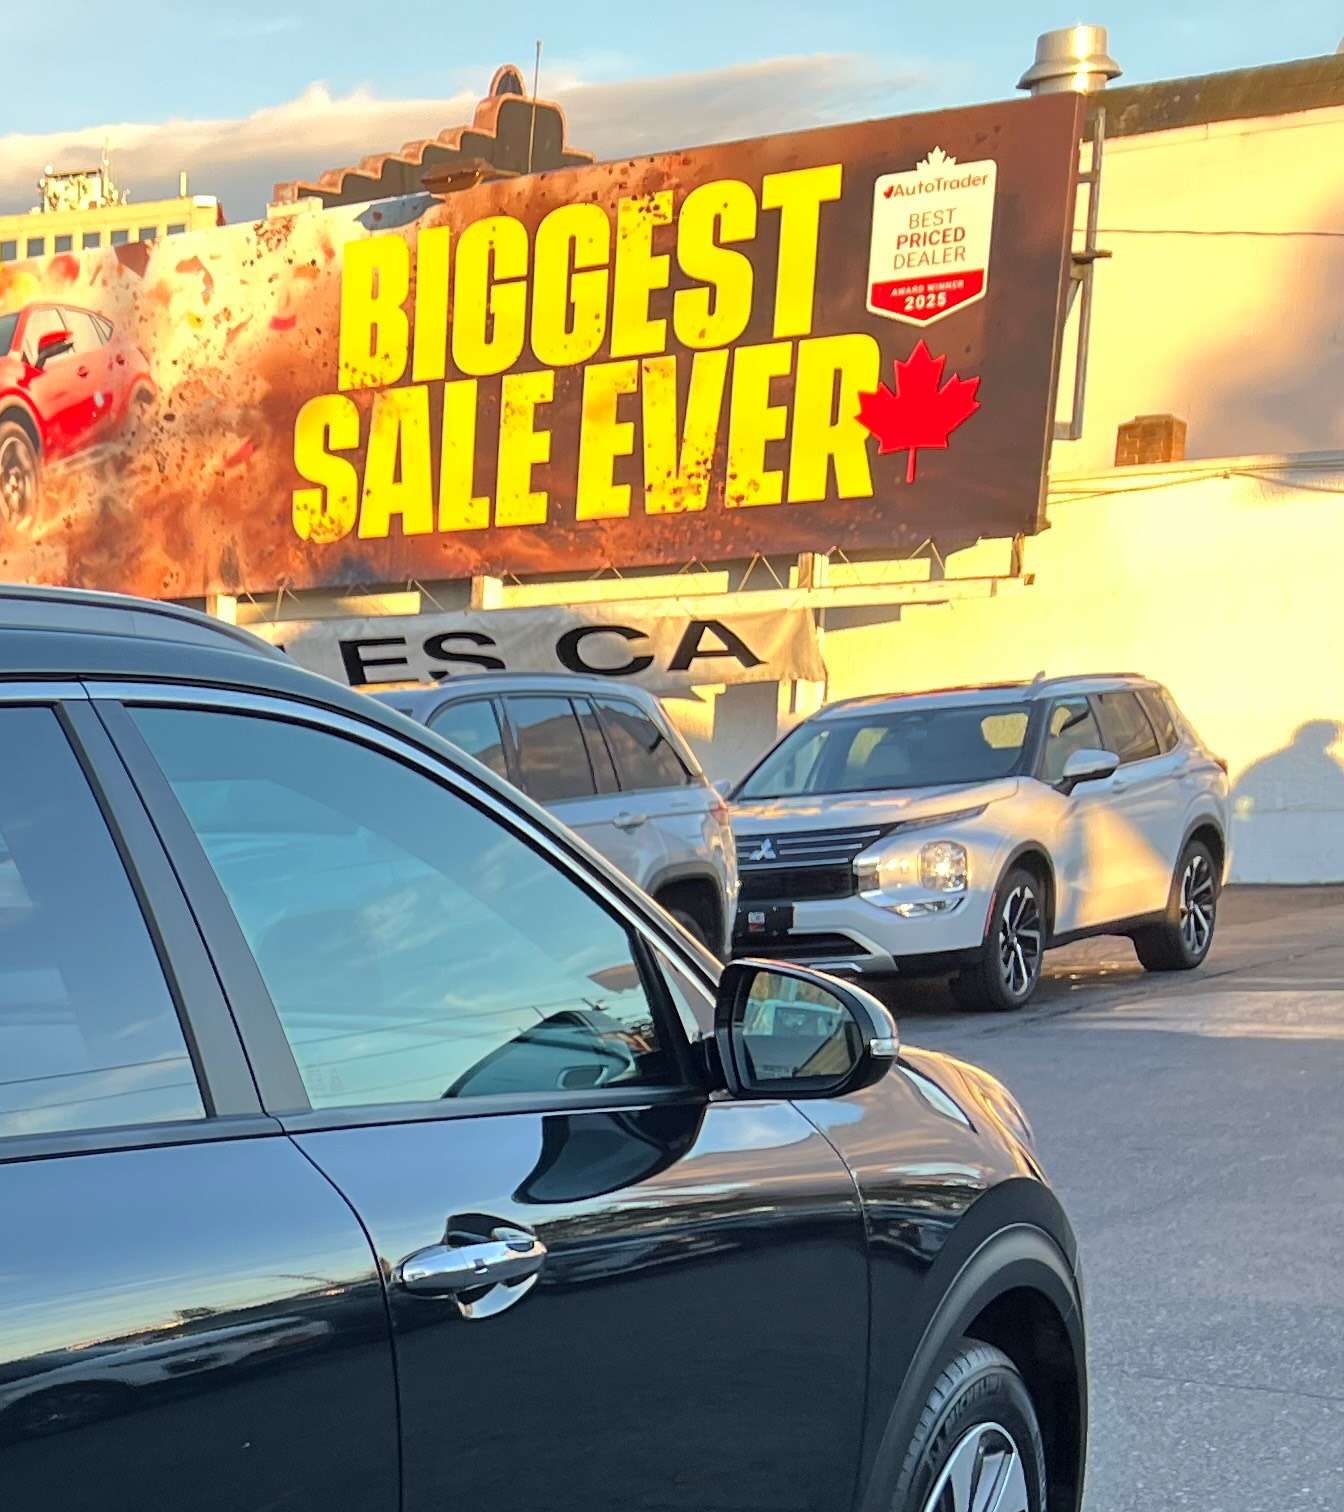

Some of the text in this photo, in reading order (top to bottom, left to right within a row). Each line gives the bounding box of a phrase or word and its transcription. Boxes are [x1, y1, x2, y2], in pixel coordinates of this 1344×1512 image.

[893, 173, 989, 198] AutoTrader
[908, 207, 957, 230] BEST
[896, 226, 966, 250] PRICED
[893, 245, 966, 271] DEALER
[338, 162, 842, 391] BIGGEST
[890, 279, 965, 297] AWARD WINNER
[903, 292, 947, 311] 2025
[291, 333, 881, 544] SALE EVER
[272, 620, 768, 685] ES CA
